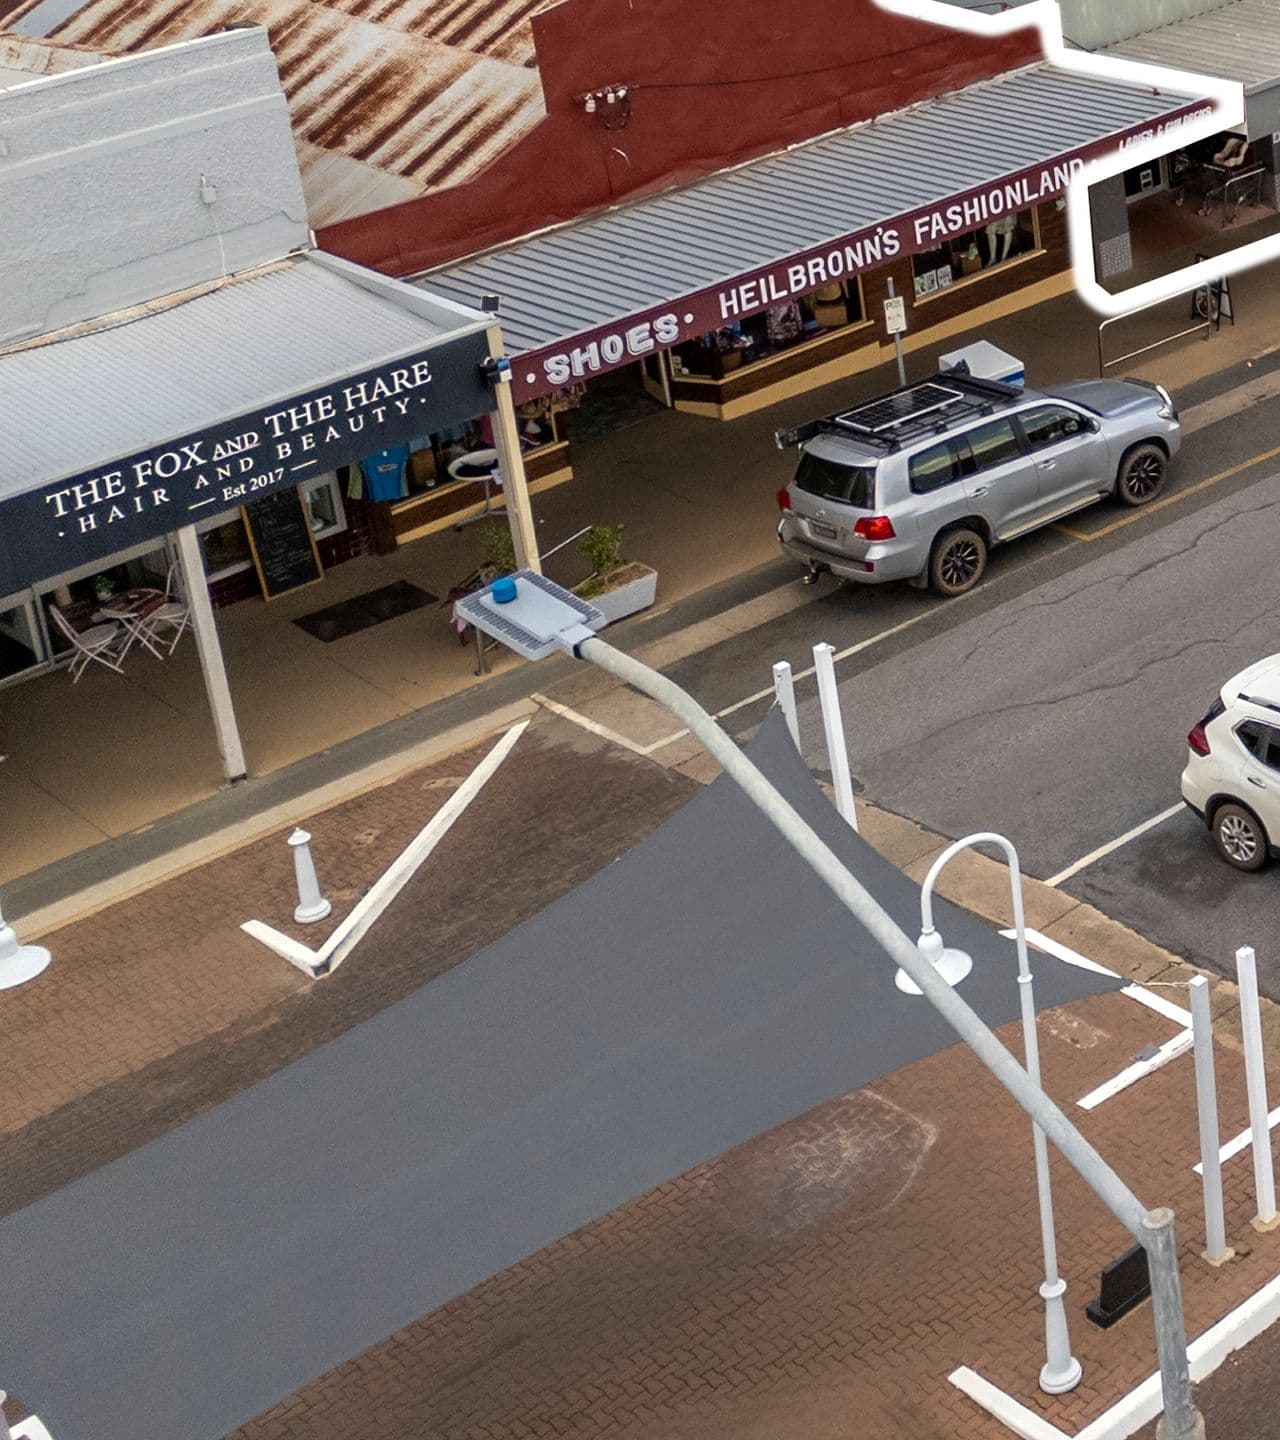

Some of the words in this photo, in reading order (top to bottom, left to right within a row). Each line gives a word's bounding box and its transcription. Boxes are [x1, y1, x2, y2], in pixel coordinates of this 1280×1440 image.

[543, 313, 680, 386] SHOES
[719, 227, 901, 319] HEILBRONN'S
[913, 157, 1085, 245] FASHIONLAND
[46, 471, 127, 518] THE
[132, 441, 208, 488] FOX
[211, 430, 261, 461] AND
[264, 395, 337, 438] THE
[341, 360, 433, 412] HARE
[78, 487, 171, 534] HAIR
[194, 456, 255, 491] AND
[276, 396, 412, 460] BEAUTY
[222, 483, 247, 503] Est
[249, 466, 286, 493] 2017
